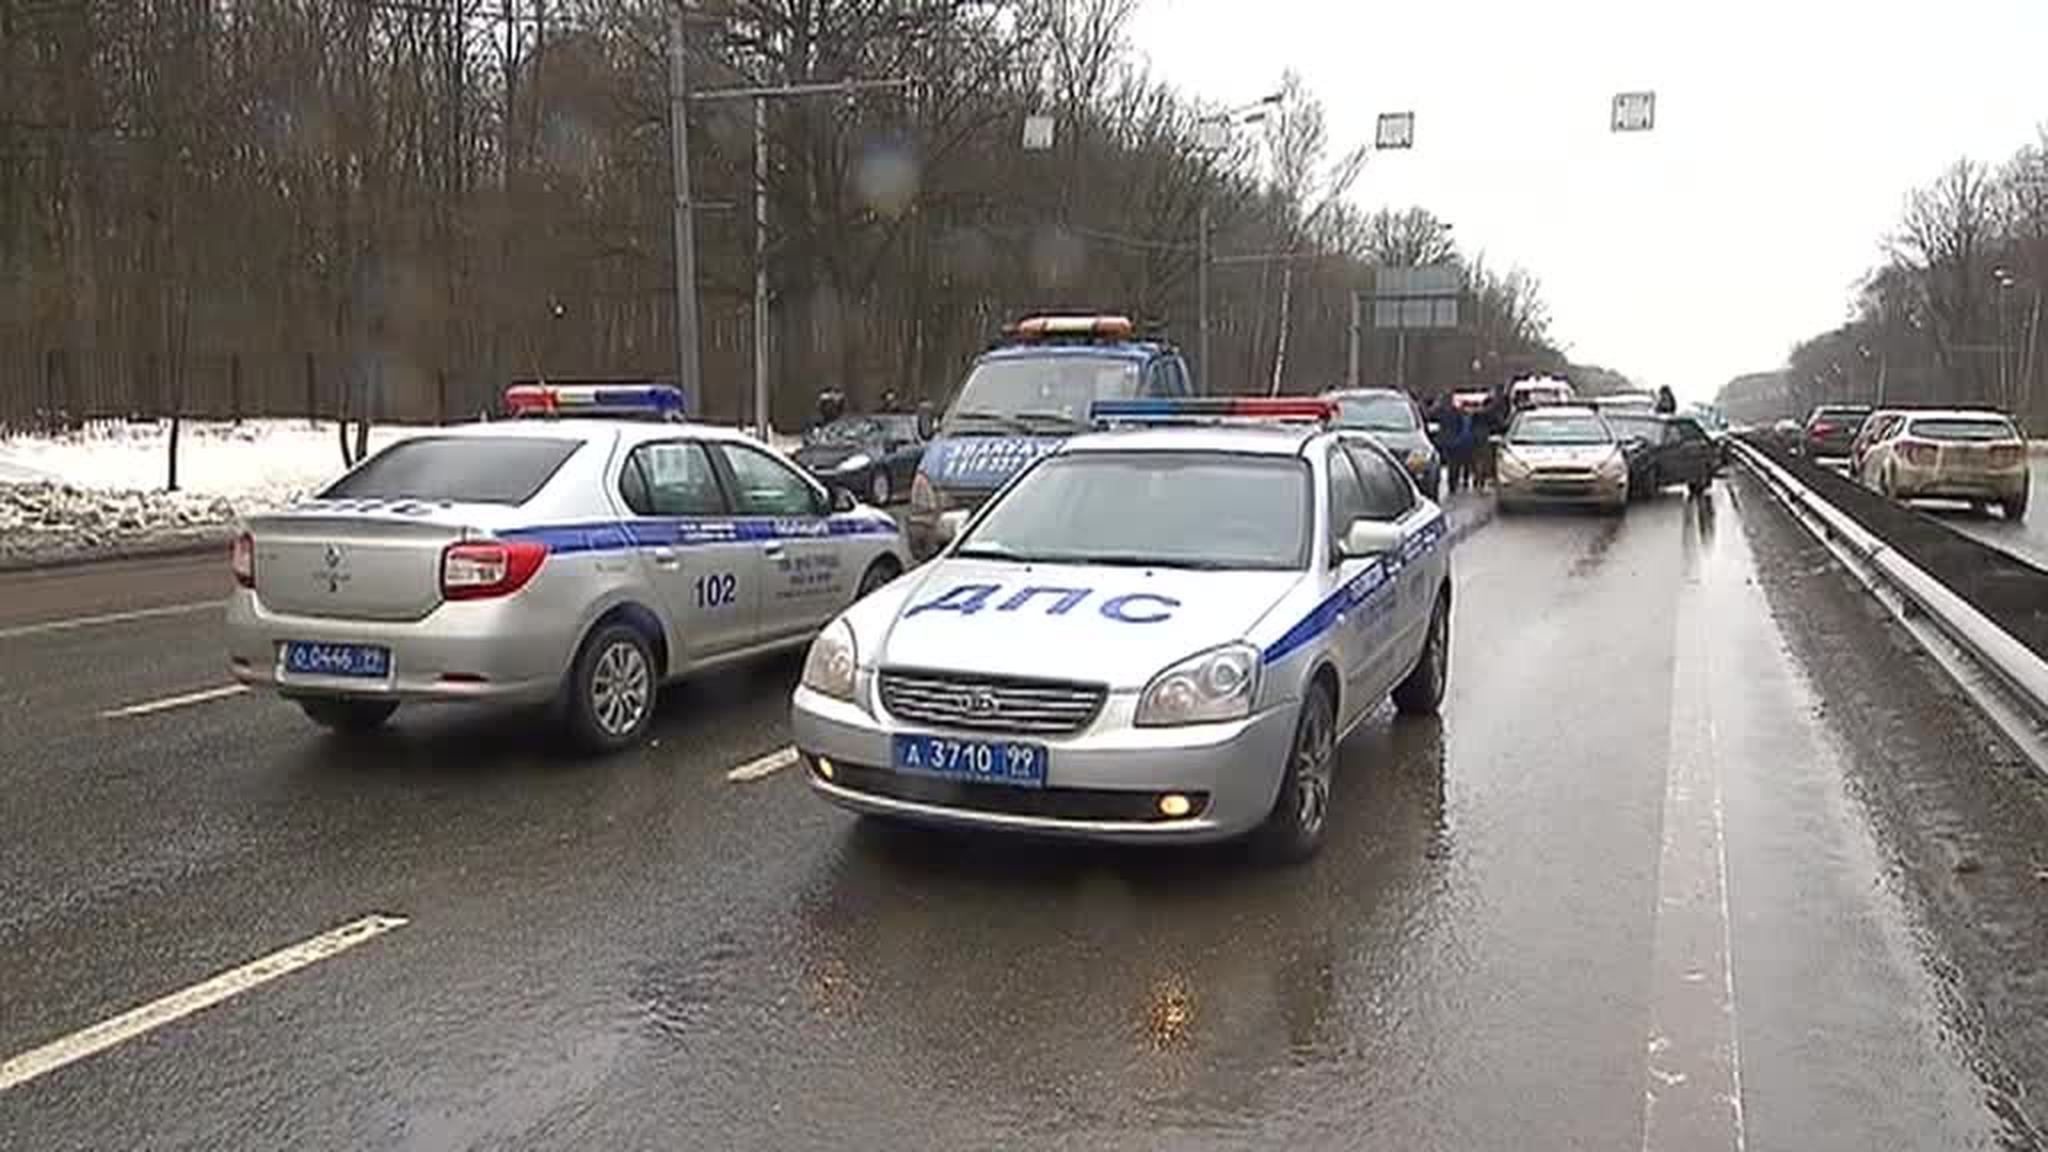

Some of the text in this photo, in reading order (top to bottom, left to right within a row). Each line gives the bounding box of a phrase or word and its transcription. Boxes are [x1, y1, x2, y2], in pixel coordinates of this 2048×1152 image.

[695, 574, 736, 609] 102
[903, 584, 1181, 624] ДПС
[930, 739, 993, 772] 3710
